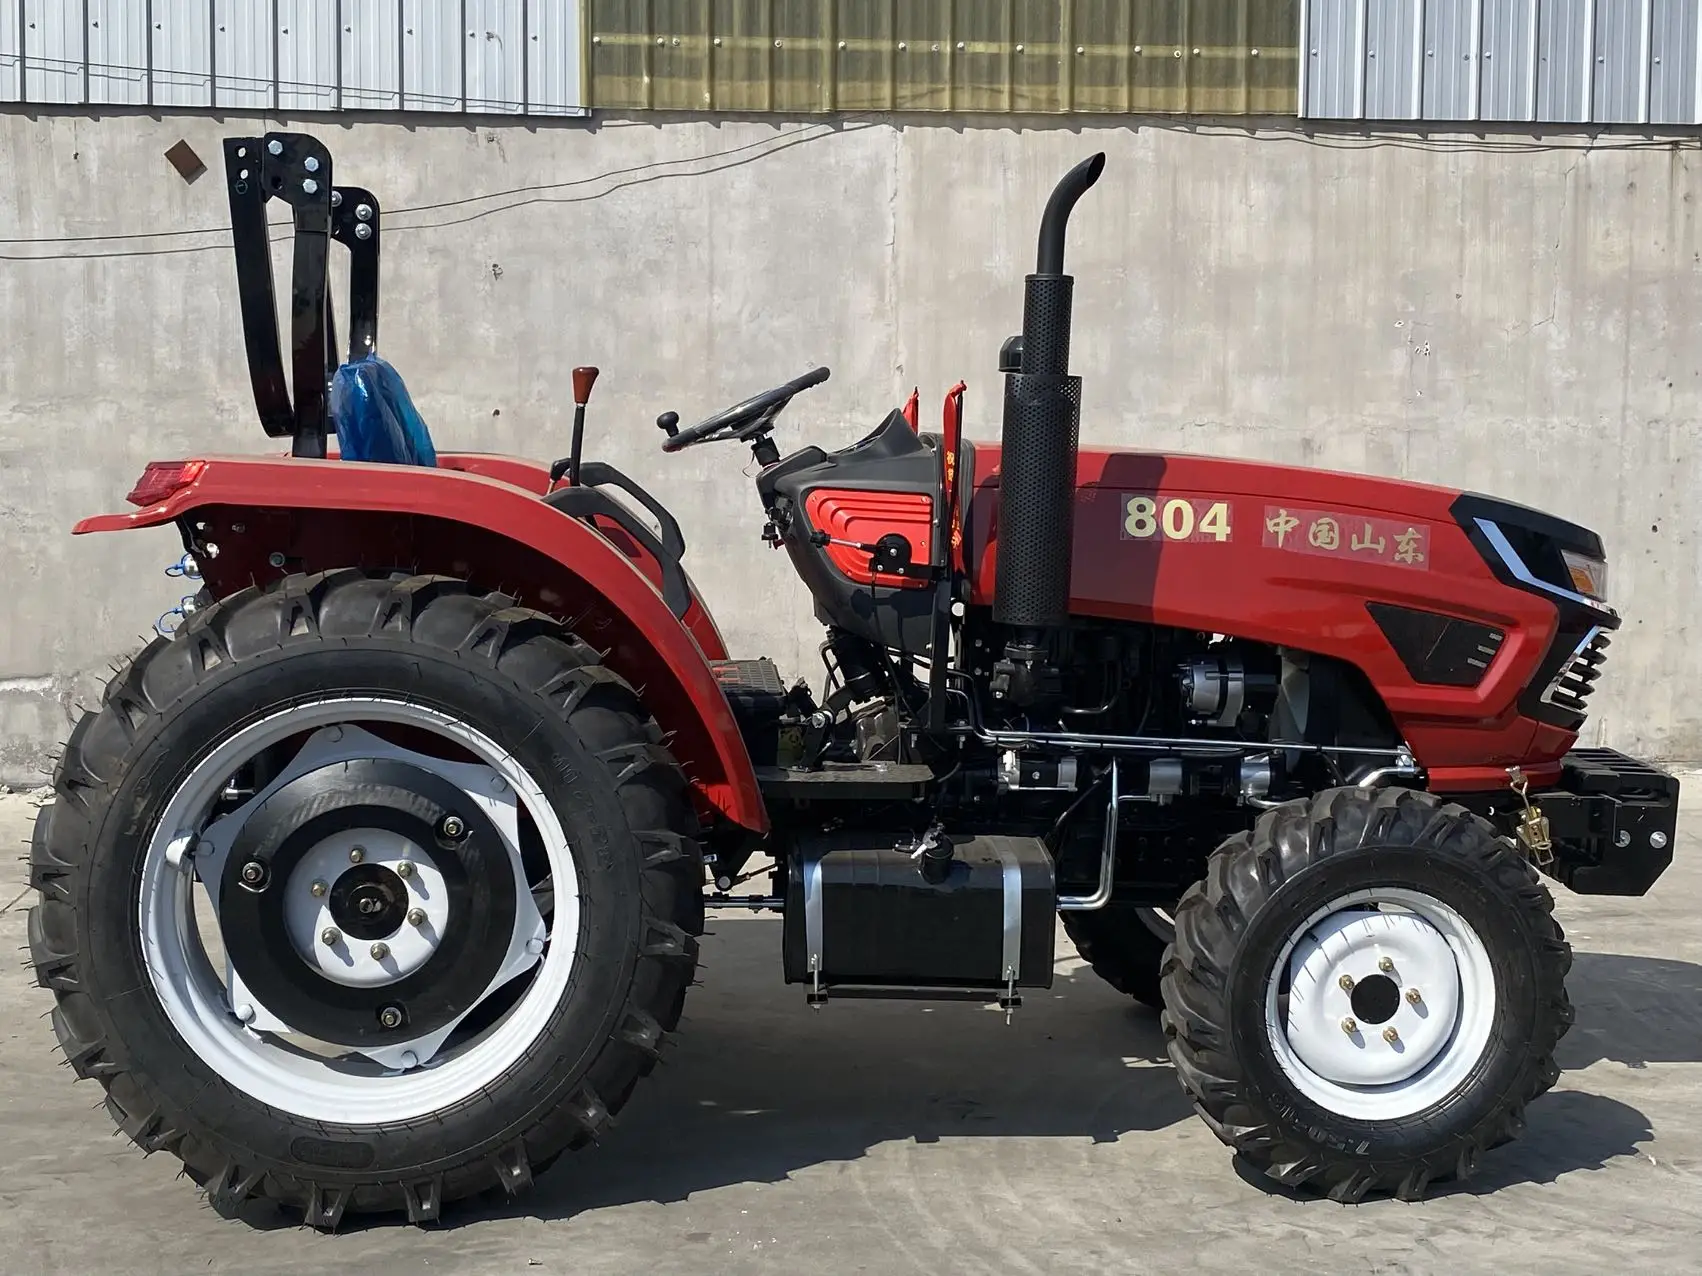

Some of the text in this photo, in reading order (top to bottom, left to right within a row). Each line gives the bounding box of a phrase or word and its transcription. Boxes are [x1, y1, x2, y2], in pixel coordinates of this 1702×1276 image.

[1124, 496, 1231, 541] 804
[1266, 508, 1425, 564] 中国山东
